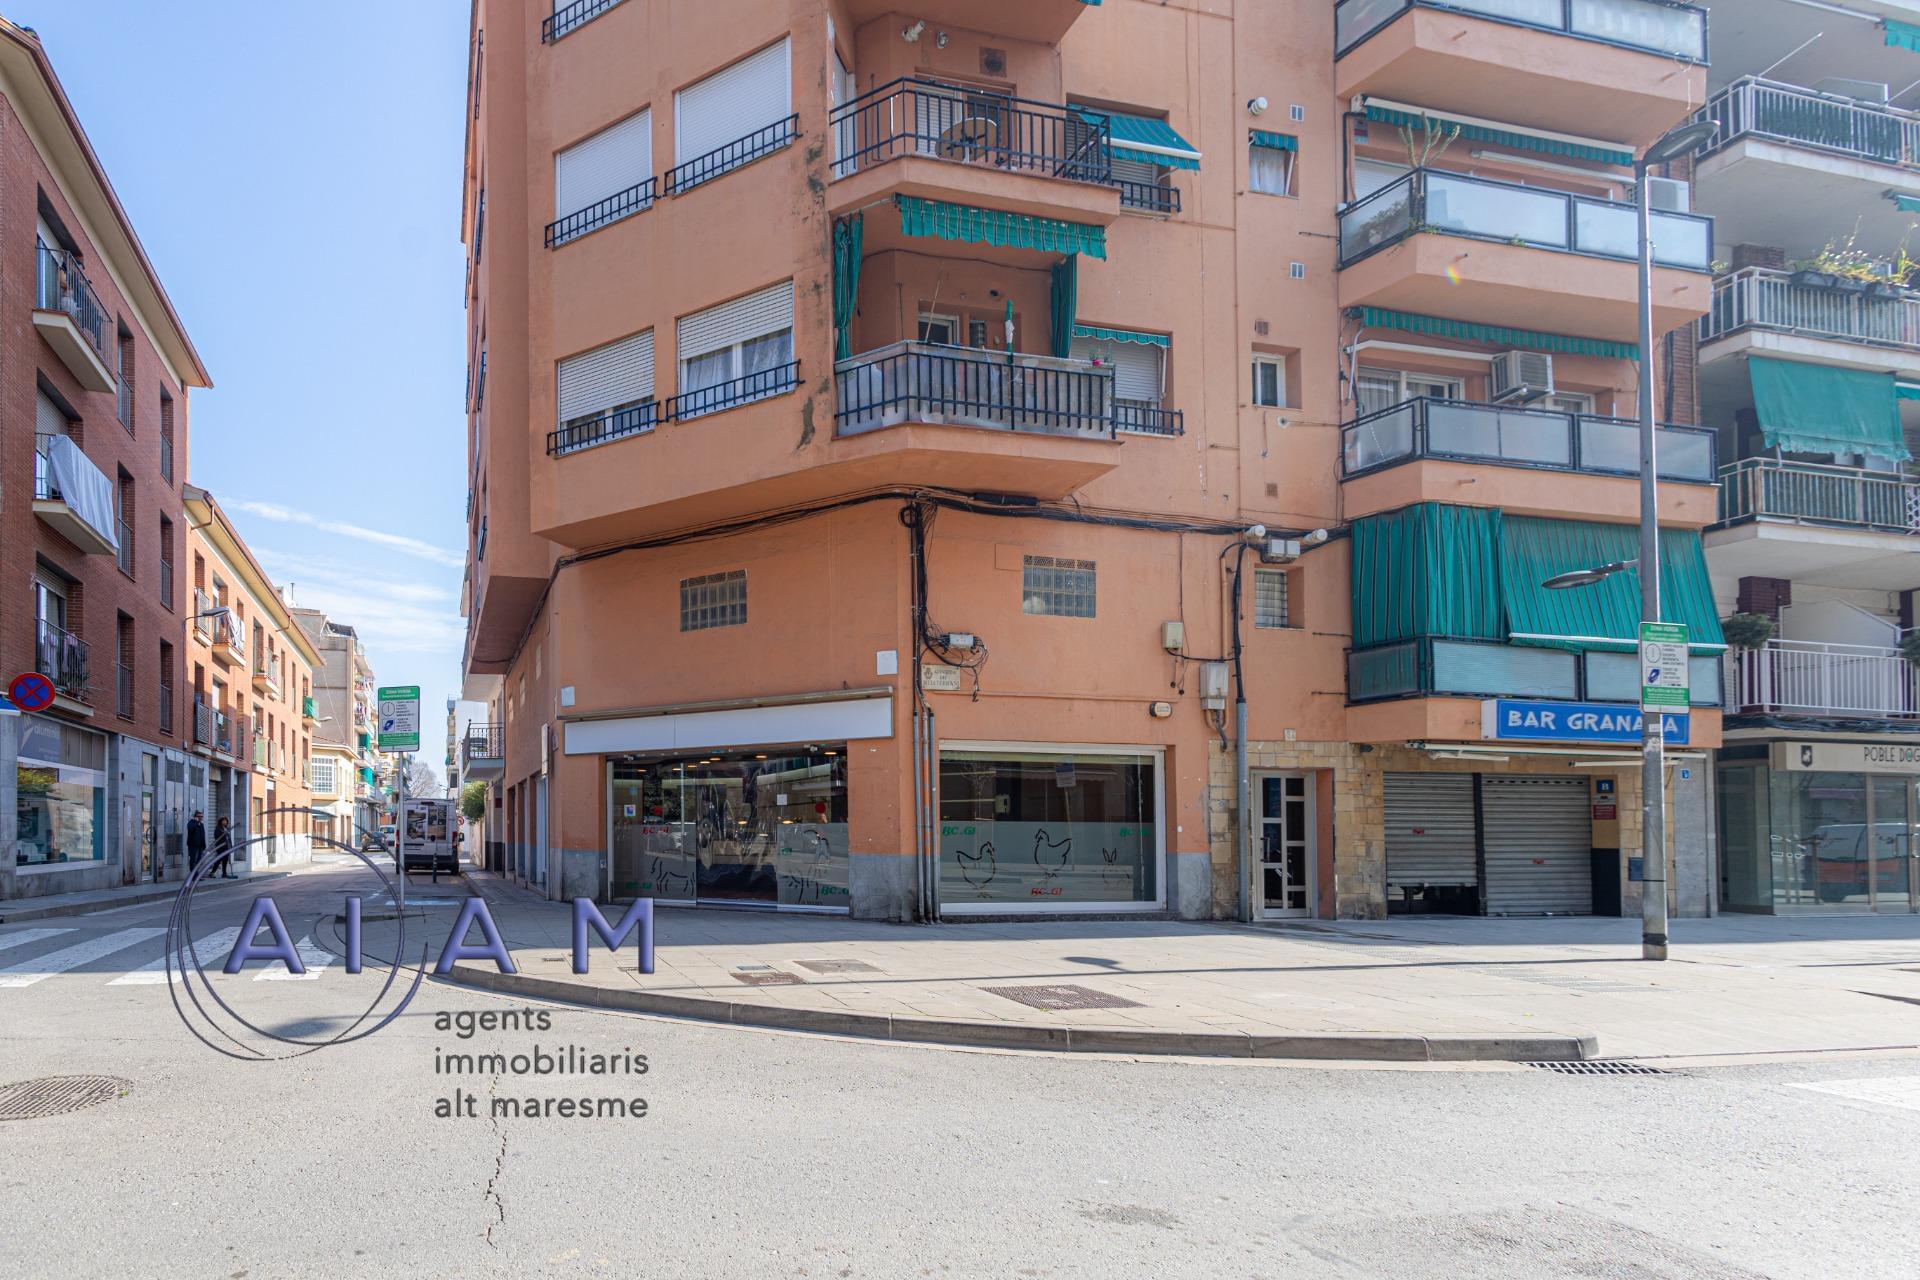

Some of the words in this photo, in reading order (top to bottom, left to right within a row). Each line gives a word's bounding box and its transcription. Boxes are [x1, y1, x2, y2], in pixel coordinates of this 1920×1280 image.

[1508, 710, 1556, 731] BAR
[1567, 713, 1679, 734] GRANAA
[1863, 746, 1896, 762] POBLE
